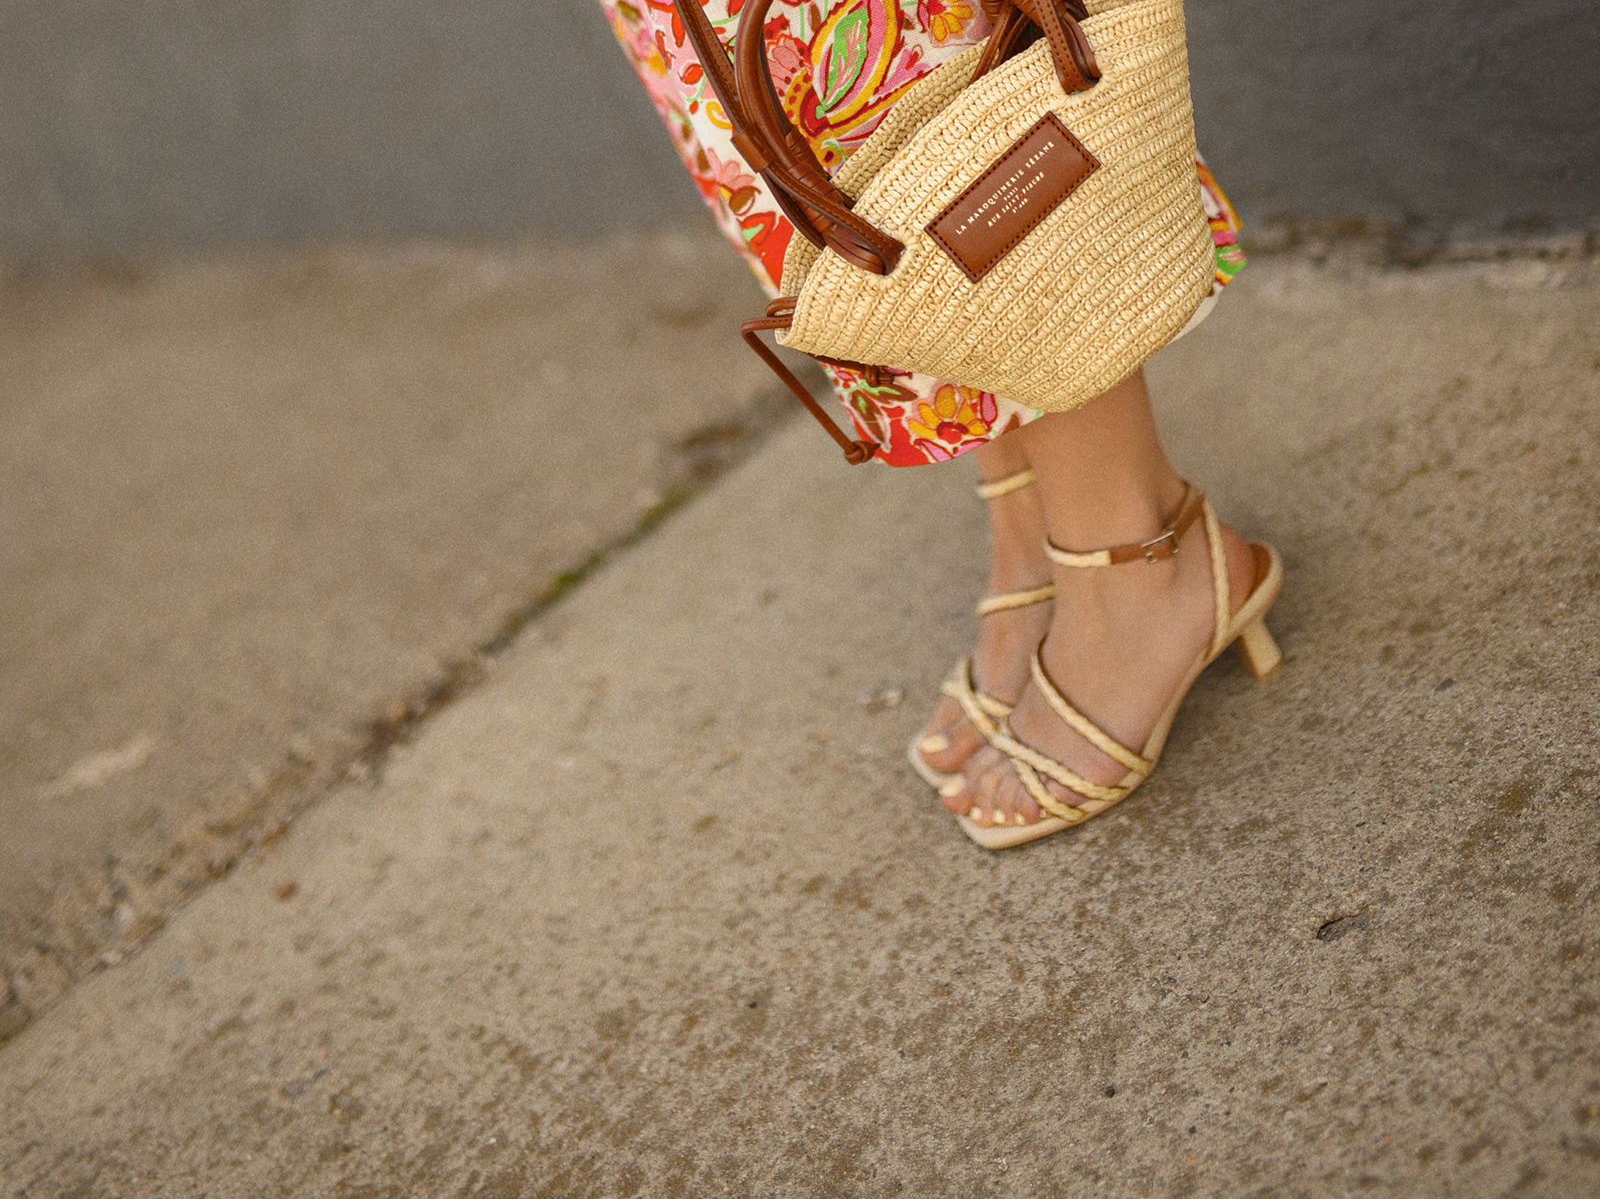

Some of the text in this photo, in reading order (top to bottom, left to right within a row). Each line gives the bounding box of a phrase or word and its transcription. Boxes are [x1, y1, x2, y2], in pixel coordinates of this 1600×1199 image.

[956, 225, 967, 235] LA
[967, 169, 1024, 224] MAROQUINERIE
[1025, 141, 1054, 168] SÉZANE
[988, 213, 1001, 227] RUE
